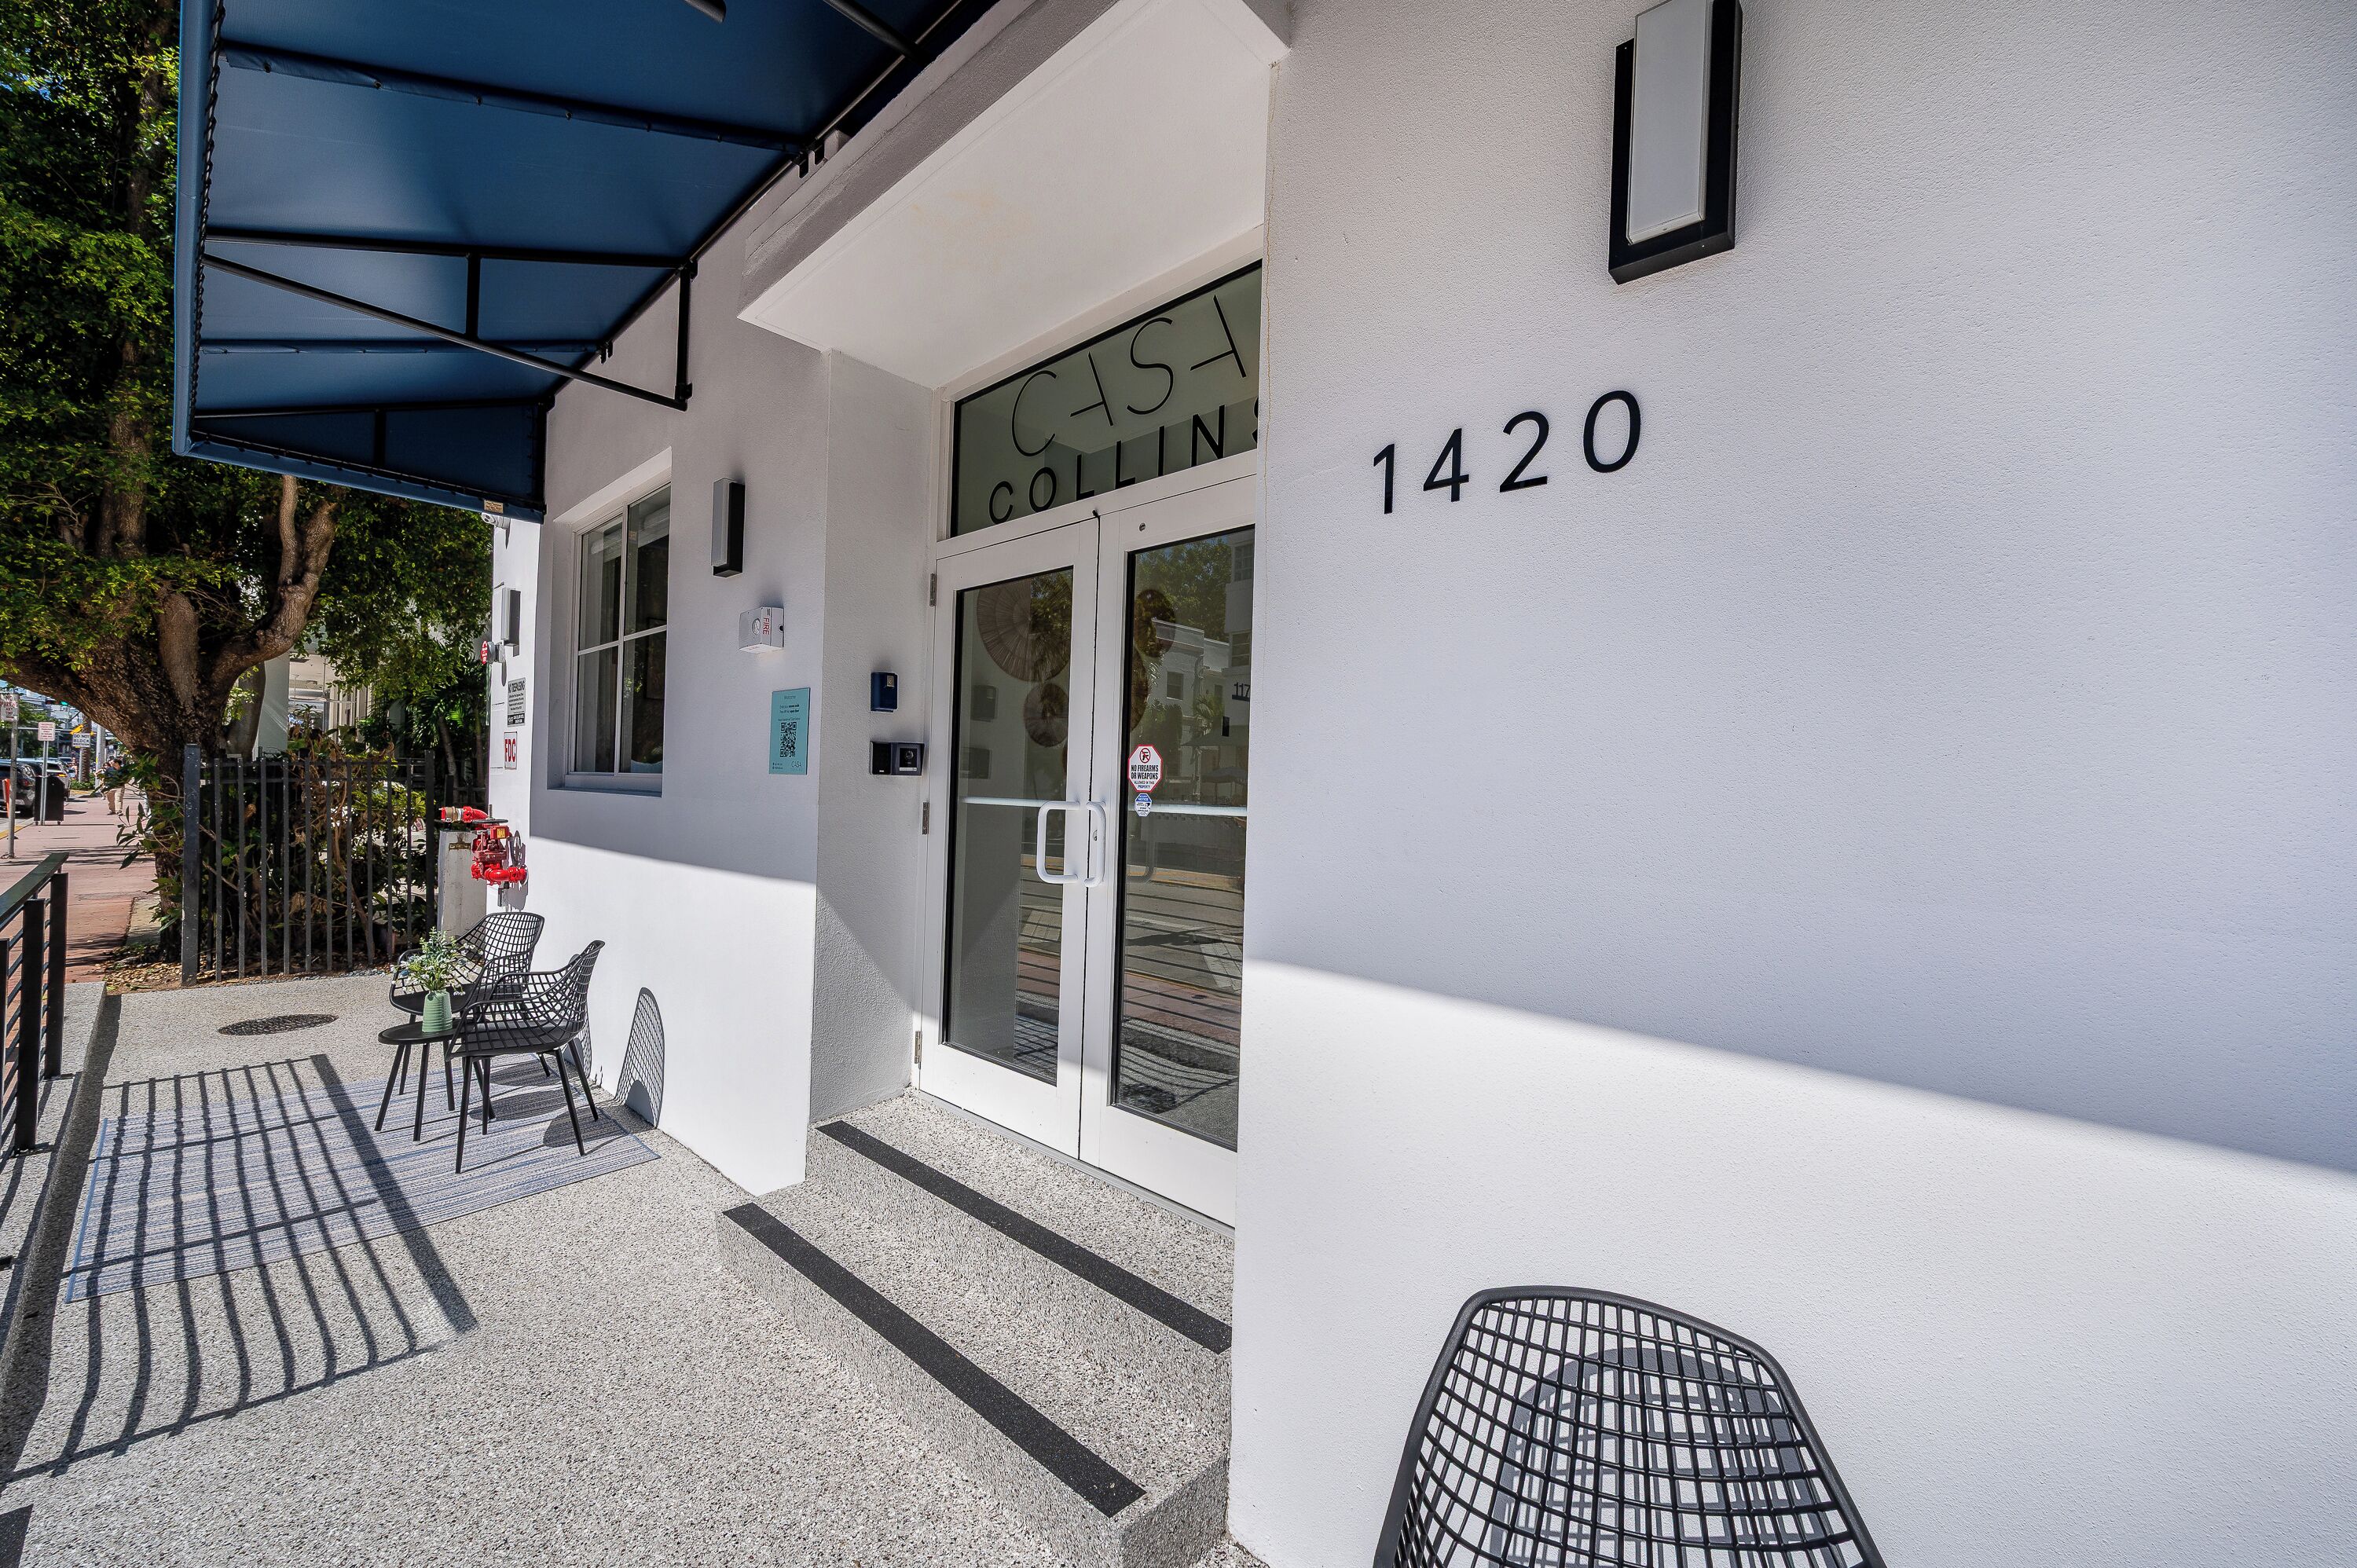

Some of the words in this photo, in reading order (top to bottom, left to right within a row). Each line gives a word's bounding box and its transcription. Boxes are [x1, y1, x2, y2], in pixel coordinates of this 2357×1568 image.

[1012, 294, 1247, 457] CASA
[1373, 390, 1641, 515] 1420
[504, 738, 515, 762] FDC
